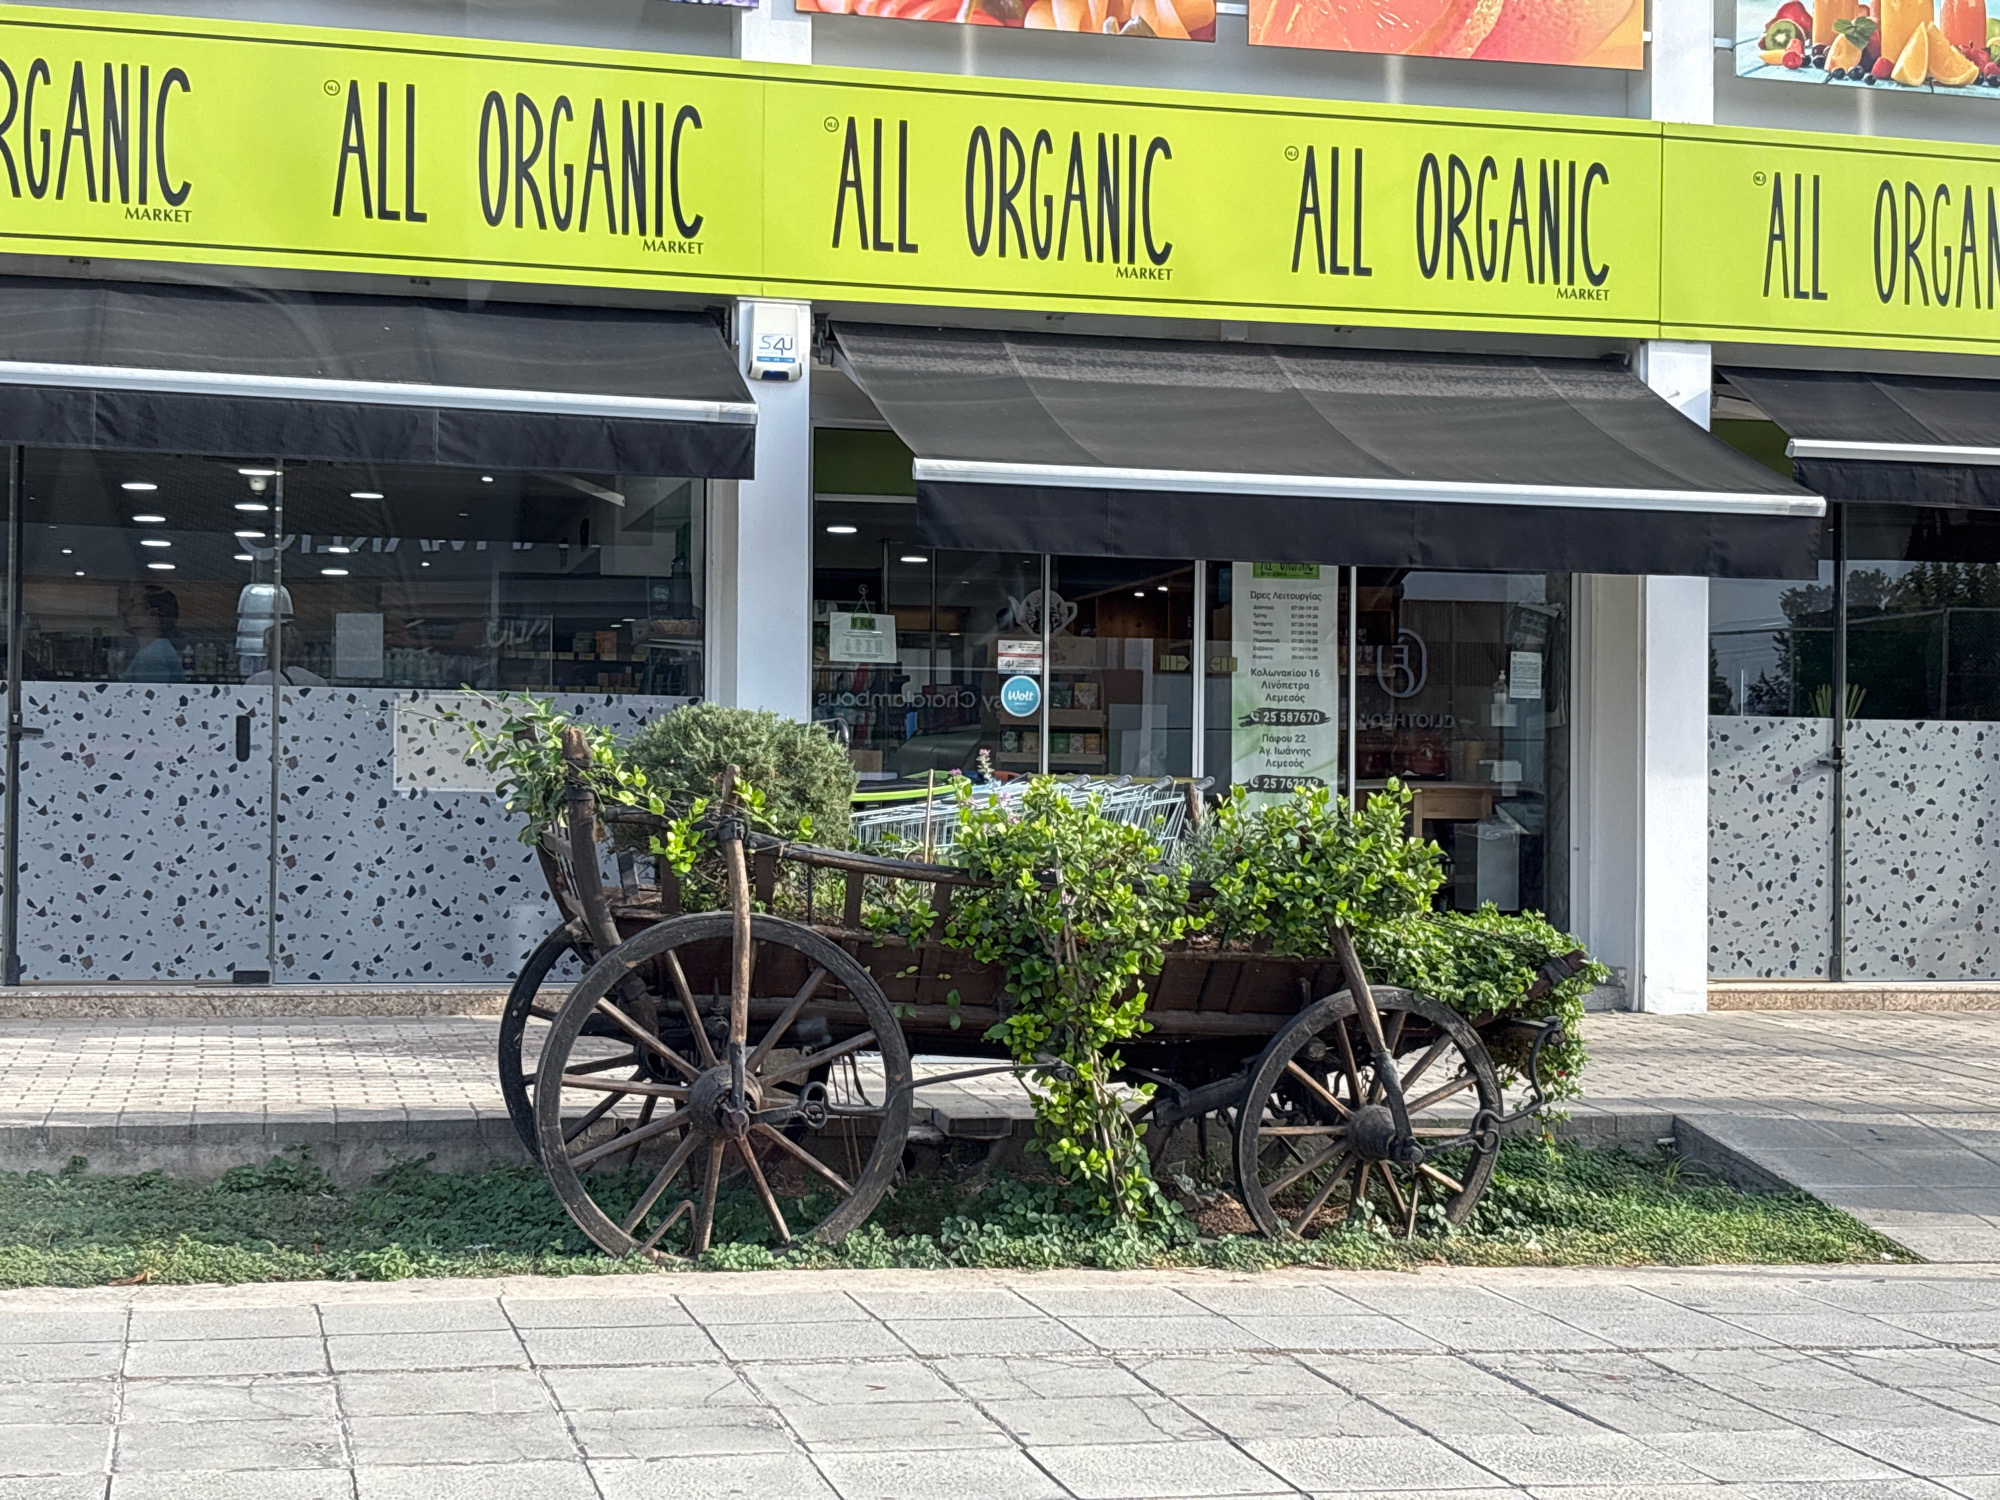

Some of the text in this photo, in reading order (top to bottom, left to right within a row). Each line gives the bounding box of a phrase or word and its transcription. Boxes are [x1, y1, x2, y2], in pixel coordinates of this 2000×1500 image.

[333, 80, 704, 239] ALL ORGANIC
[832, 116, 1172, 266] ALL ORGANIC
[124, 207, 192, 223] MARKET
[1291, 145, 1609, 287] ALL ORGANIC
[1764, 172, 1828, 300] ALL
[642, 239, 704, 254] MARKET
[1116, 266, 1172, 281] MARKET
[1556, 287, 1610, 301] MARKET
[759, 335, 793, 356] S4U
[1250, 590, 1322, 602] Ώρες Λειτουργίας
[1250, 668, 1320, 678] Κολωνακίου 16
[1261, 681, 1310, 691] Λινόπετρα
[1008, 690, 1034, 701] Wolt
[1265, 693, 1306, 703] Λεμεσός
[1263, 711, 1320, 723] 25 587670
[1262, 734, 1306, 745] Πάφου 22
[1274, 746, 1312, 757] Ιωάννης
[1265, 759, 1305, 769] Λεμεσός
[1263, 778, 1278, 789] 25
